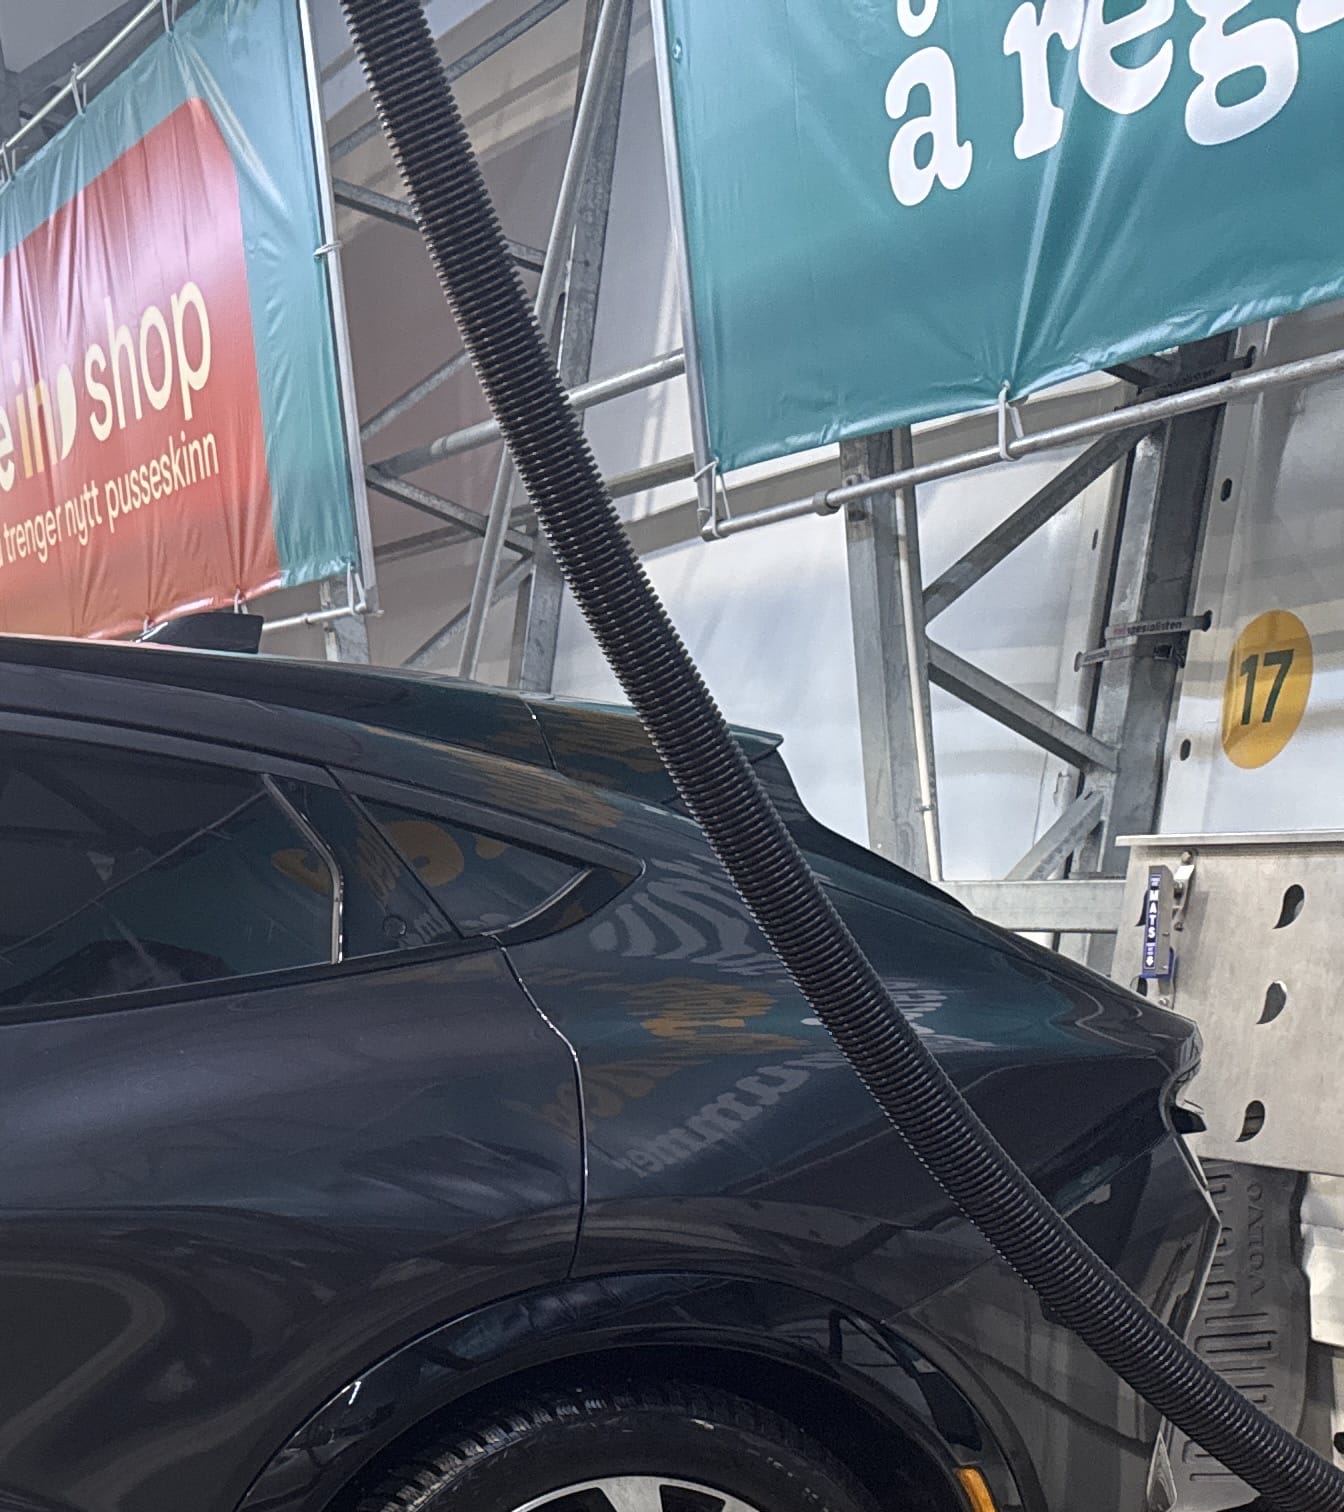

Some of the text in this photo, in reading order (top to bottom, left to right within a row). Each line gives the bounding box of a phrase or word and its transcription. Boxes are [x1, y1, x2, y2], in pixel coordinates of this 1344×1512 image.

[1003, 0, 1344, 160] reg
[85, 281, 212, 442] shop
[3, 506, 62, 564] trenger
[66, 480, 103, 546] nytt
[106, 431, 220, 534] pusseskinn
[1240, 648, 1295, 727] 17
[1148, 889, 1159, 939] MATS
[1247, 1180, 1265, 1297] VOLVO
